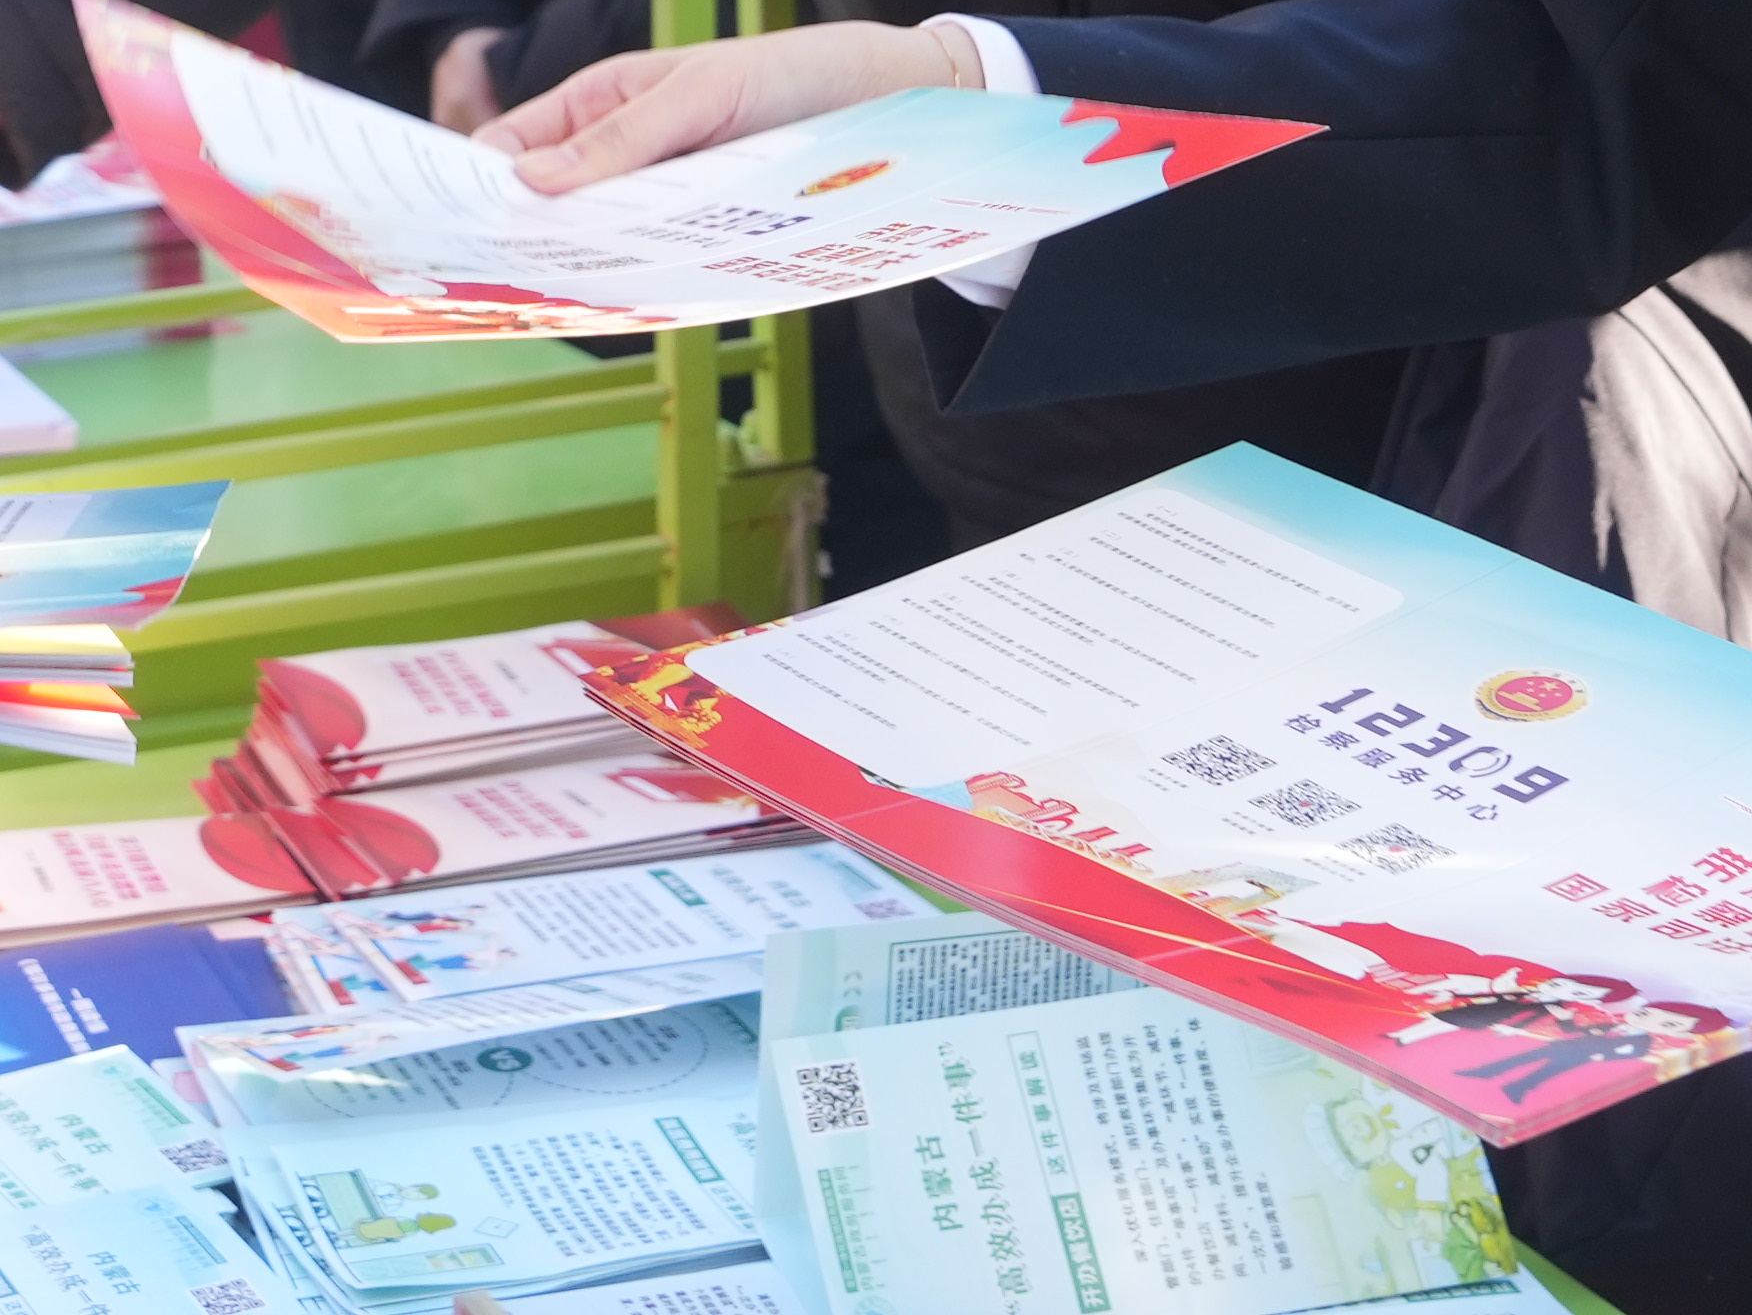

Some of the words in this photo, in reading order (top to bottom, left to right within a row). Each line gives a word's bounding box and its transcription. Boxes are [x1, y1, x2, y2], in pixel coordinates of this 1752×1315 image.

[1283, 712, 1500, 822] 检察服务中心
[1318, 687, 1571, 803] 12309
[915, 1134, 964, 1232] 内蒙古
